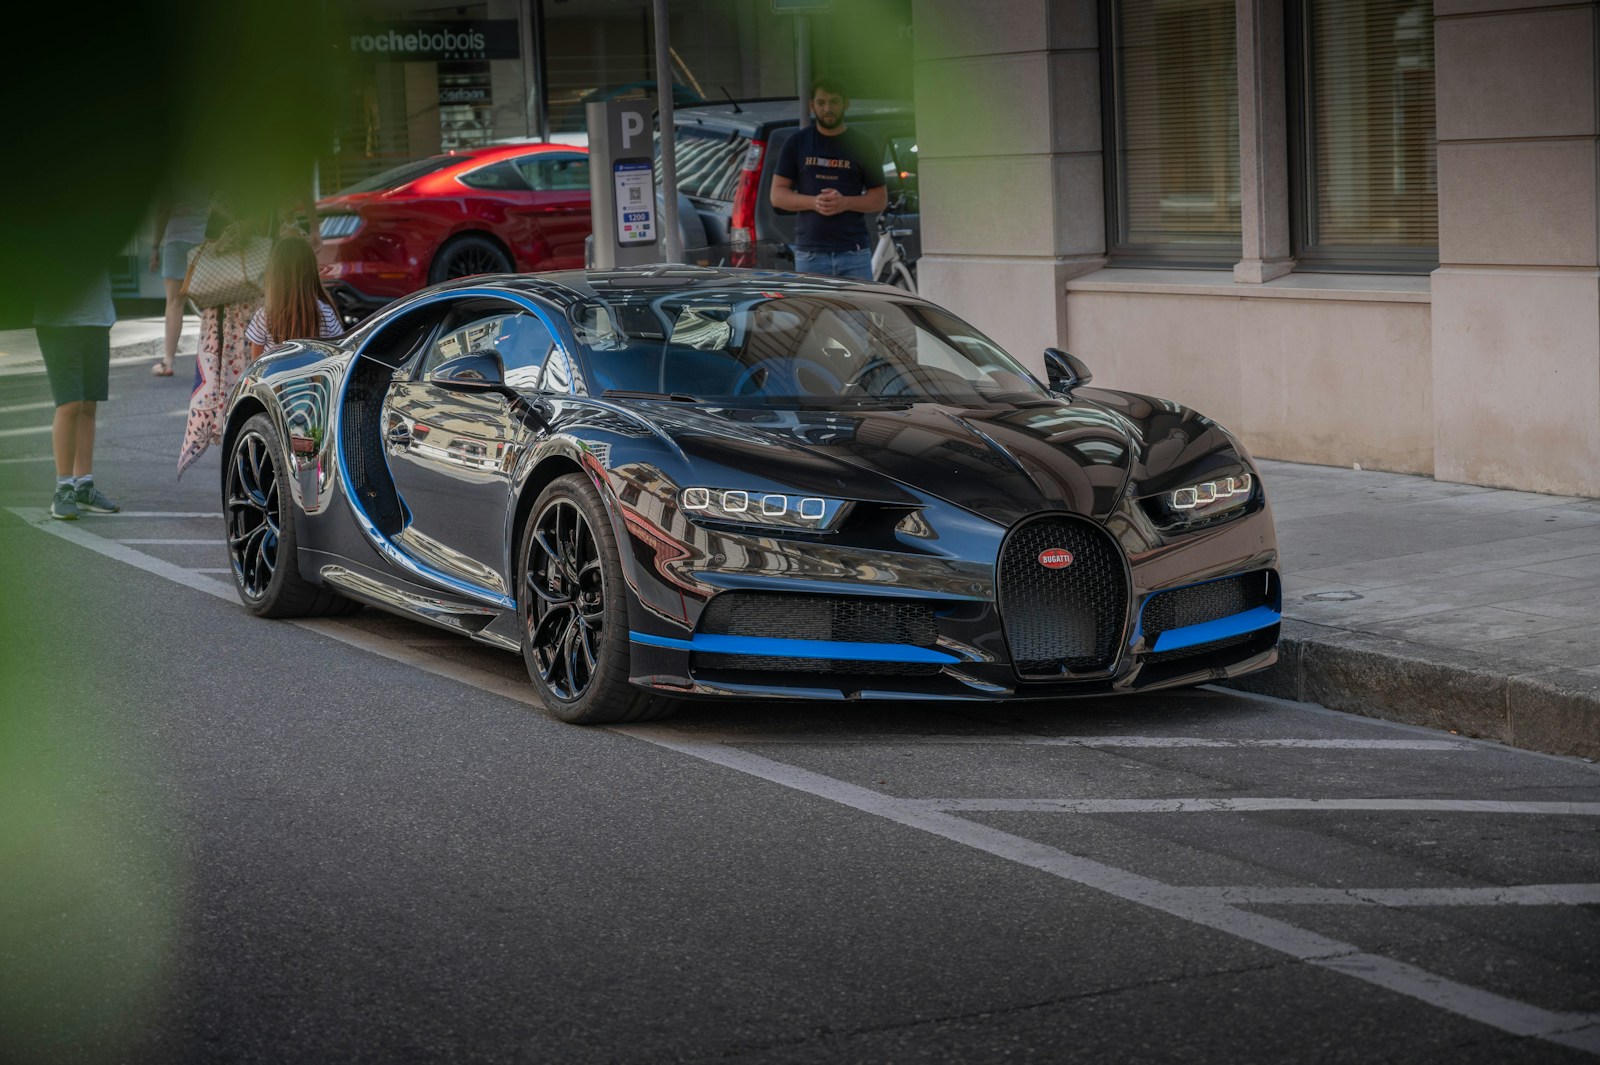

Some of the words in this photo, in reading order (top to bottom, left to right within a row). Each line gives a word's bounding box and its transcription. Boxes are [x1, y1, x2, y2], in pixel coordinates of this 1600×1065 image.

[350, 29, 485, 51] rochebobois
[621, 112, 643, 149] P
[629, 213, 645, 221] 1200
[1043, 555, 1069, 563] BUGATTI
